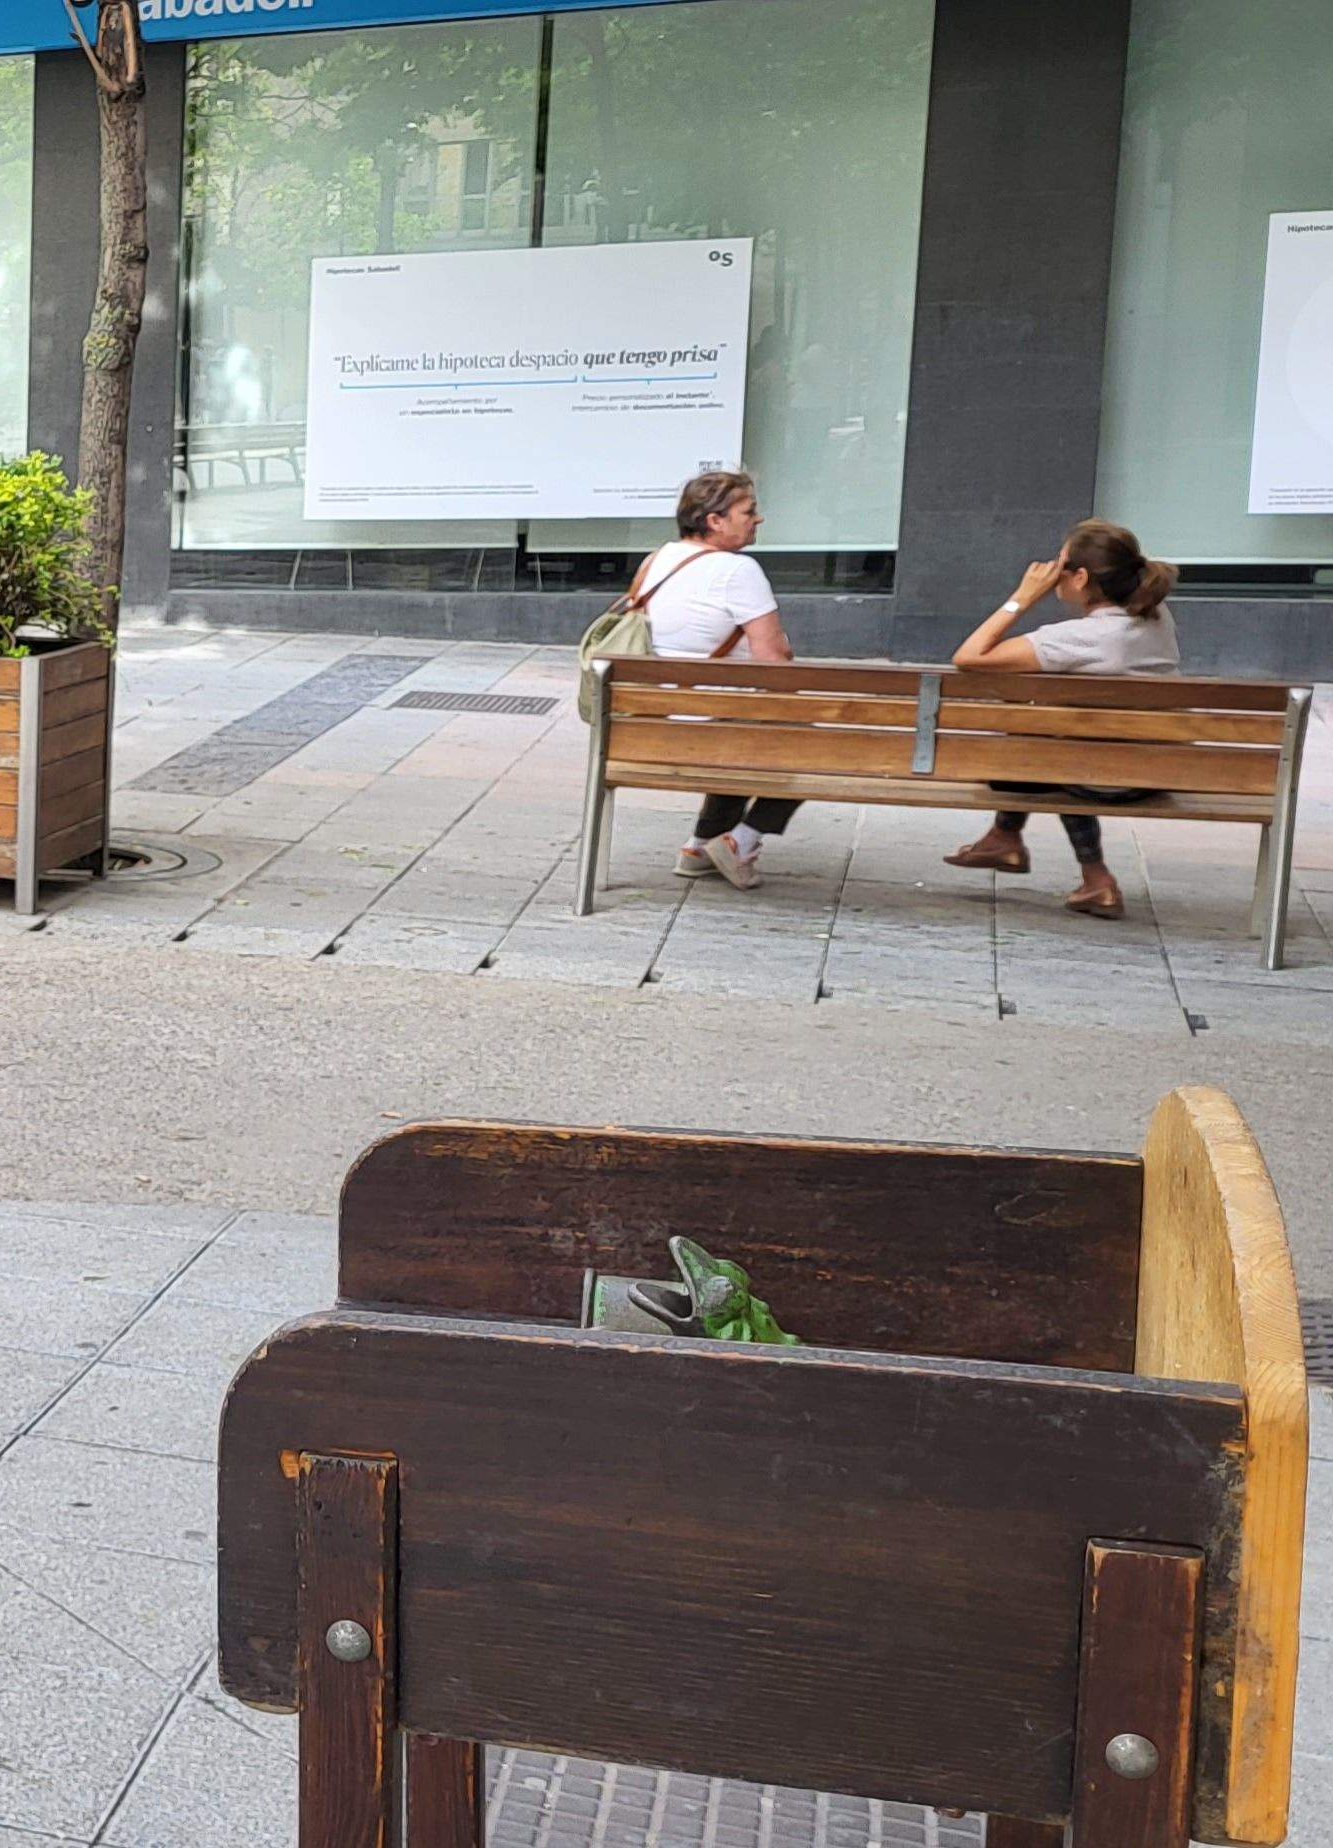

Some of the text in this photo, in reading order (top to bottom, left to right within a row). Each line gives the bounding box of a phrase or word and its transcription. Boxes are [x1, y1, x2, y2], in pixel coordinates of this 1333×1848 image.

[423, 352, 435, 371] la
[438, 352, 506, 374] hipoteca
[509, 349, 579, 371] despacio
[583, 351, 616, 369] que
[619, 349, 667, 368] tengo
